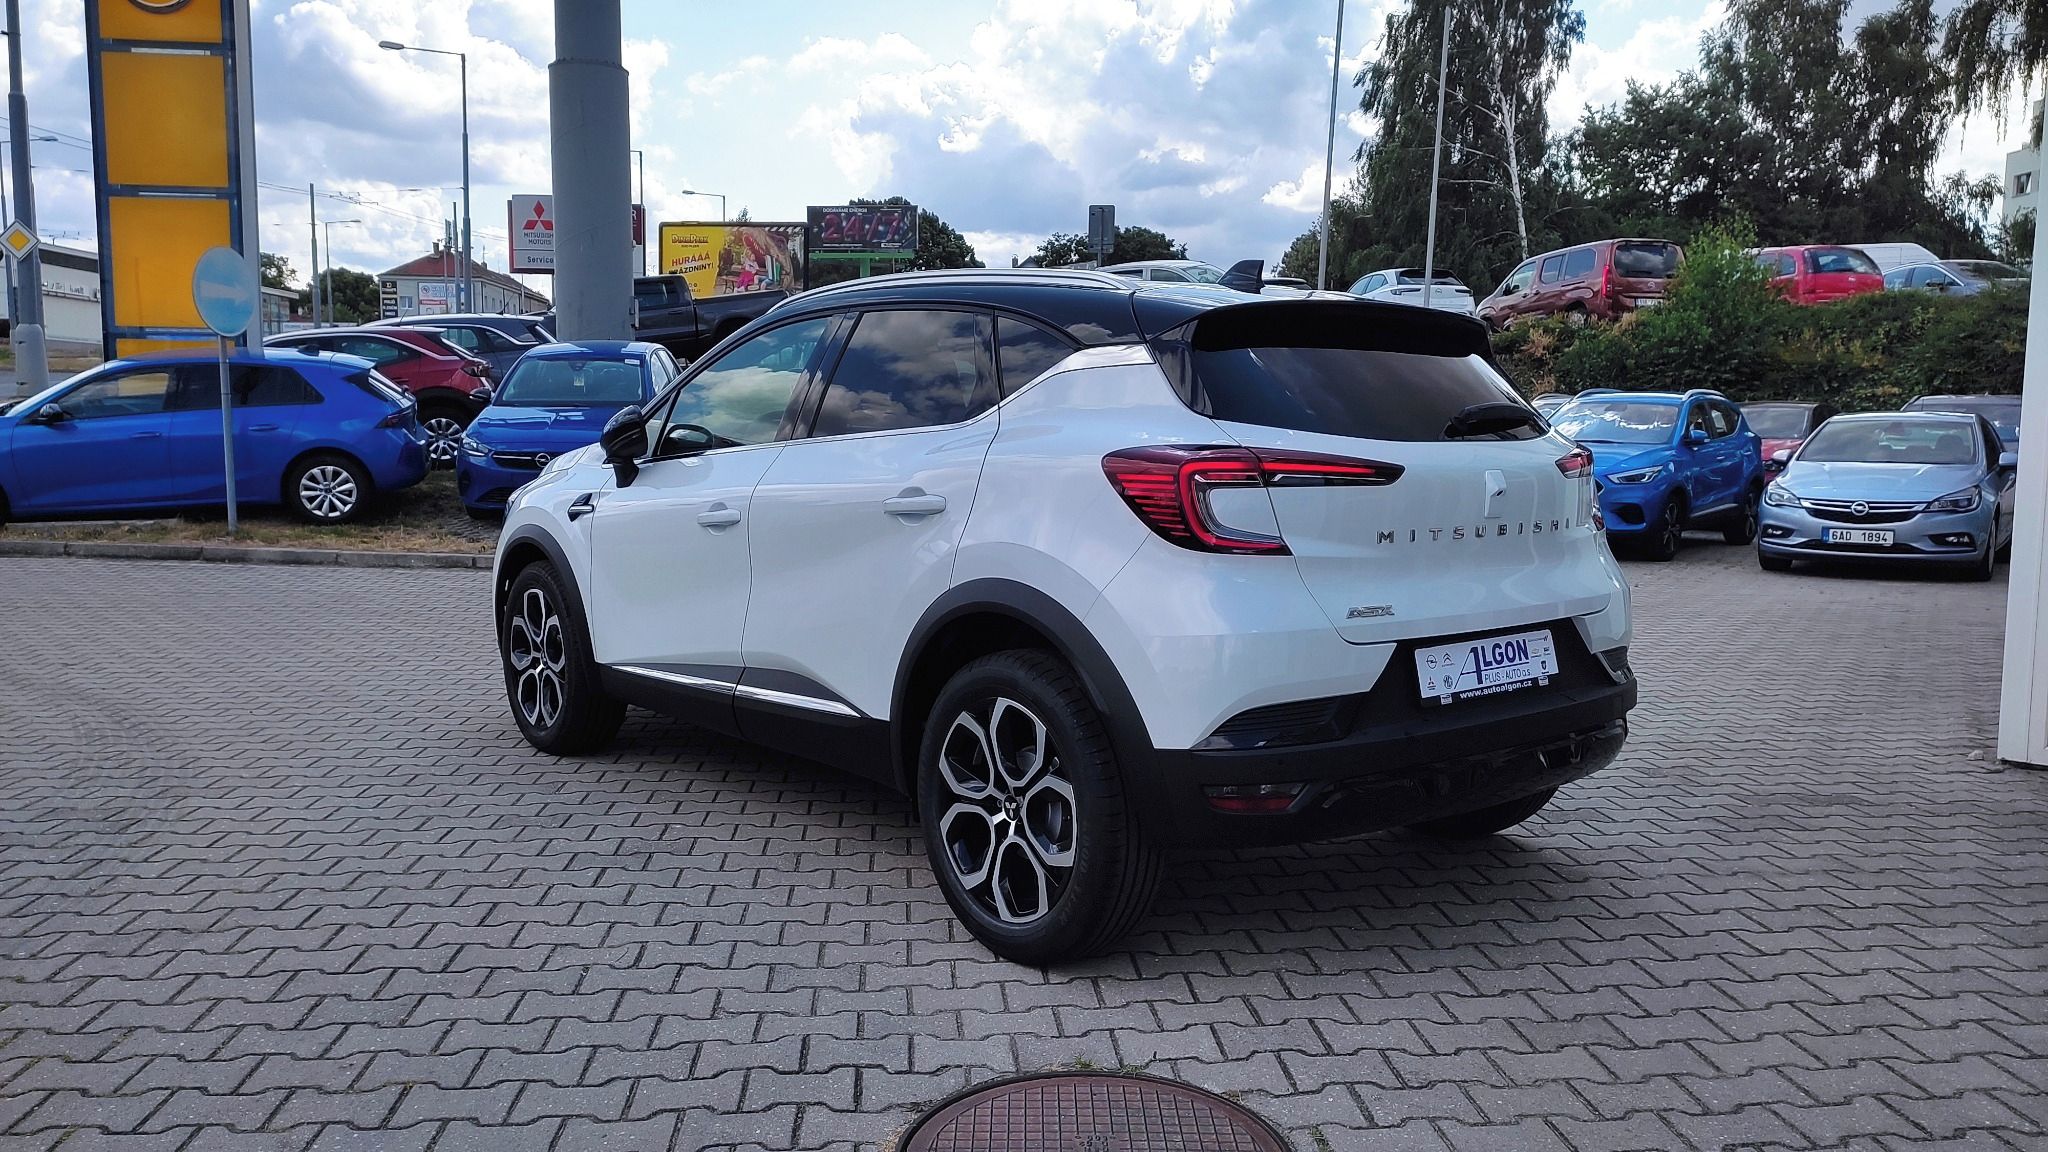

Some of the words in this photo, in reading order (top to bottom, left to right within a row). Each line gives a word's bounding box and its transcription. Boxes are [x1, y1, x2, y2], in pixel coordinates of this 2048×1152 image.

[822, 213, 901, 242] 24/7
[527, 255, 554, 264] Service
[1376, 517, 1571, 545] MITSUBISHI
[1831, 530, 1852, 541] 6AD
[1860, 532, 1888, 543] 1894
[1346, 603, 1396, 620] ASX
[1454, 638, 1530, 690] ALGON
[1459, 680, 1533, 700] www.autoalgon.cz
